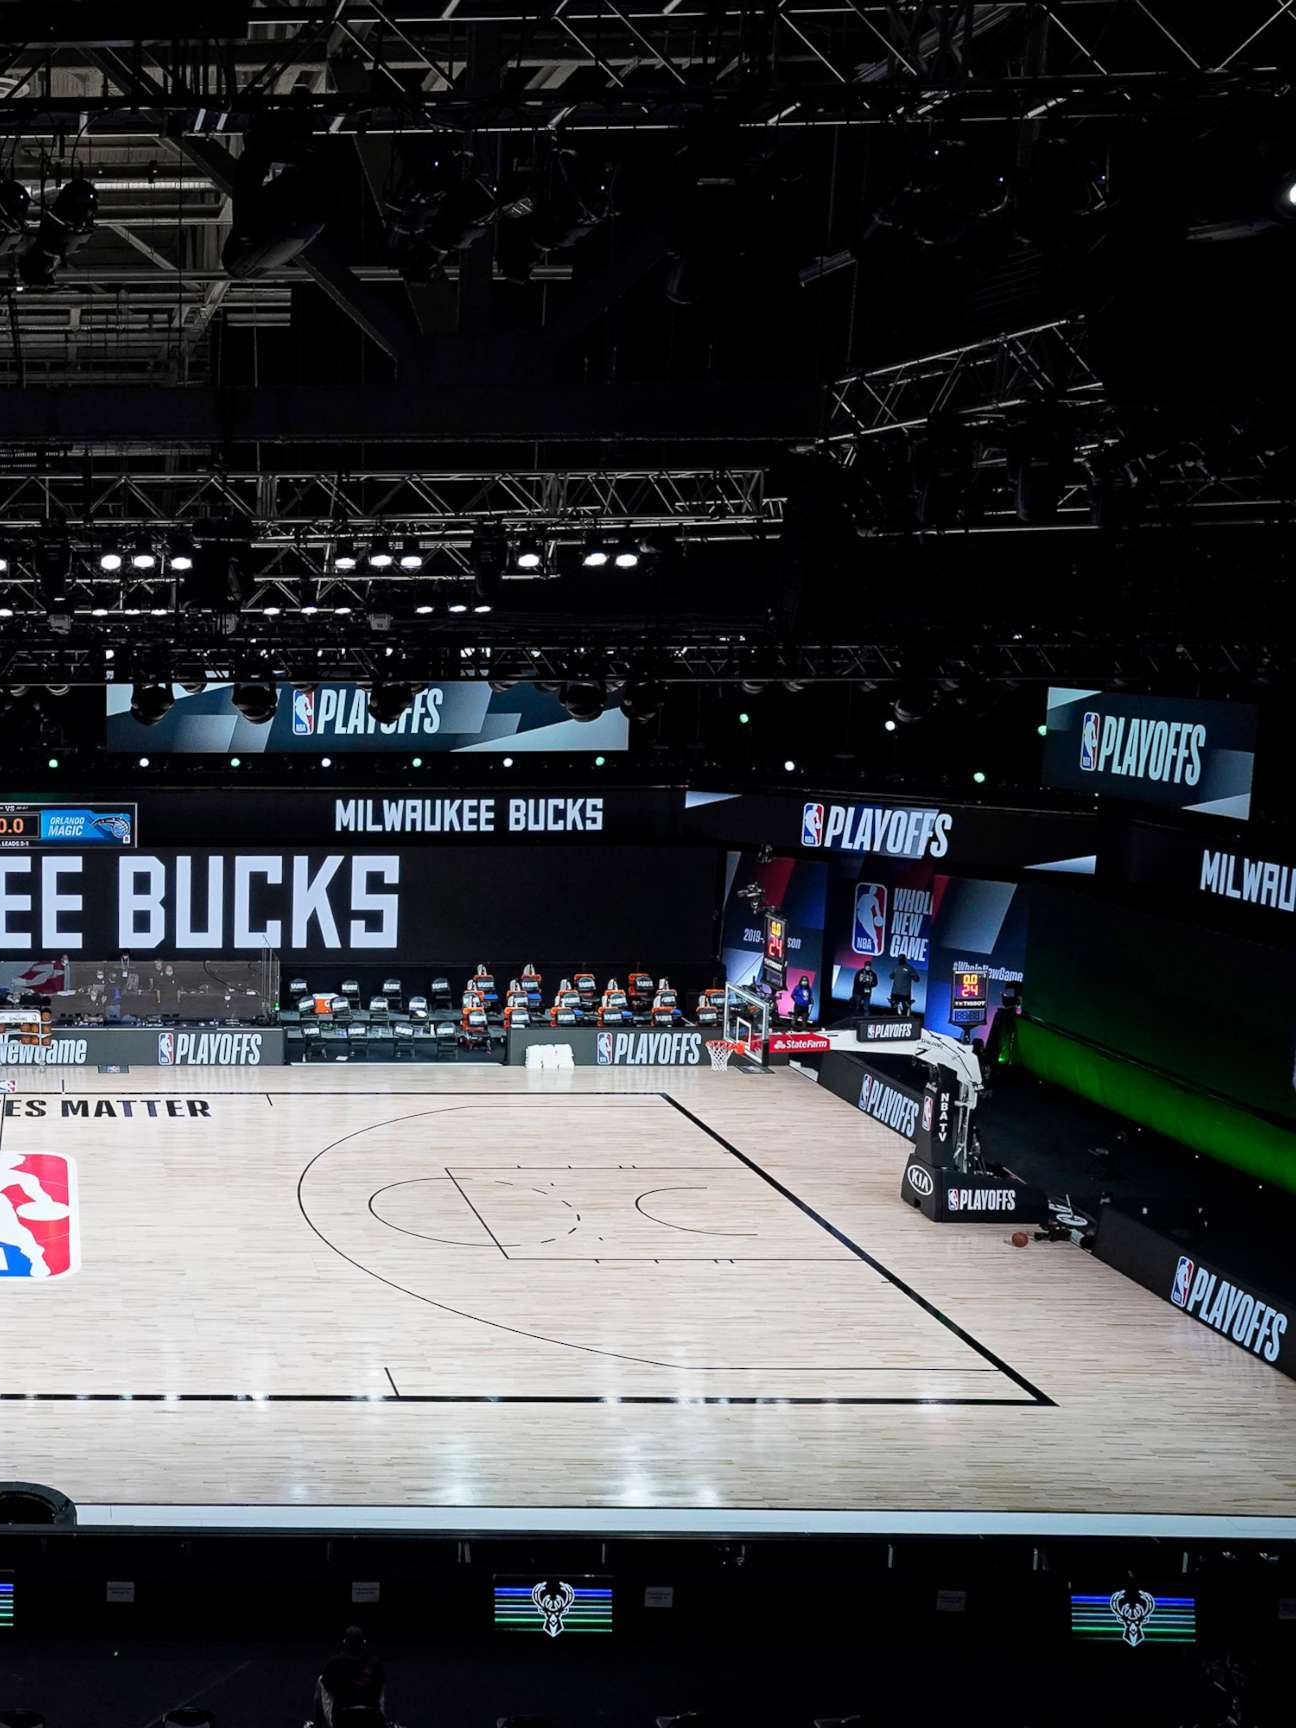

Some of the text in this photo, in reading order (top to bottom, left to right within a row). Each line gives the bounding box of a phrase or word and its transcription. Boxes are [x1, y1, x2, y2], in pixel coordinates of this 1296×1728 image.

[317, 688, 444, 734] PLAFFS
[1097, 715, 1206, 786] PLAYOFFS
[50, 816, 86, 825] ORLANDO
[335, 798, 603, 831] MILWAUKEE BUCKS
[48, 825, 84, 836] MAGIC
[824, 805, 953, 858] PLAYOFFS
[118, 856, 400, 949] BUCKS
[893, 888, 932, 914] WHOL
[891, 911, 923, 936] NEW
[769, 934, 783, 958] 24
[856, 937, 872, 951] NBA
[890, 935, 929, 962] GAME
[961, 984, 979, 997] 24
[874, 1024, 913, 1038] PLAYOFFS
[175, 1033, 262, 1065] PLAYOFFS
[614, 1032, 702, 1065] PLAYOFFS
[61, 1099, 212, 1118] MATTER
[867, 1081, 919, 1138] PLAYOFFS
[938, 1092, 950, 1142] NBA TV
[911, 1168, 929, 1192] KIA
[959, 1189, 1016, 1211] PLAYOFFS
[1186, 1266, 1288, 1362] PLAYOFFS
